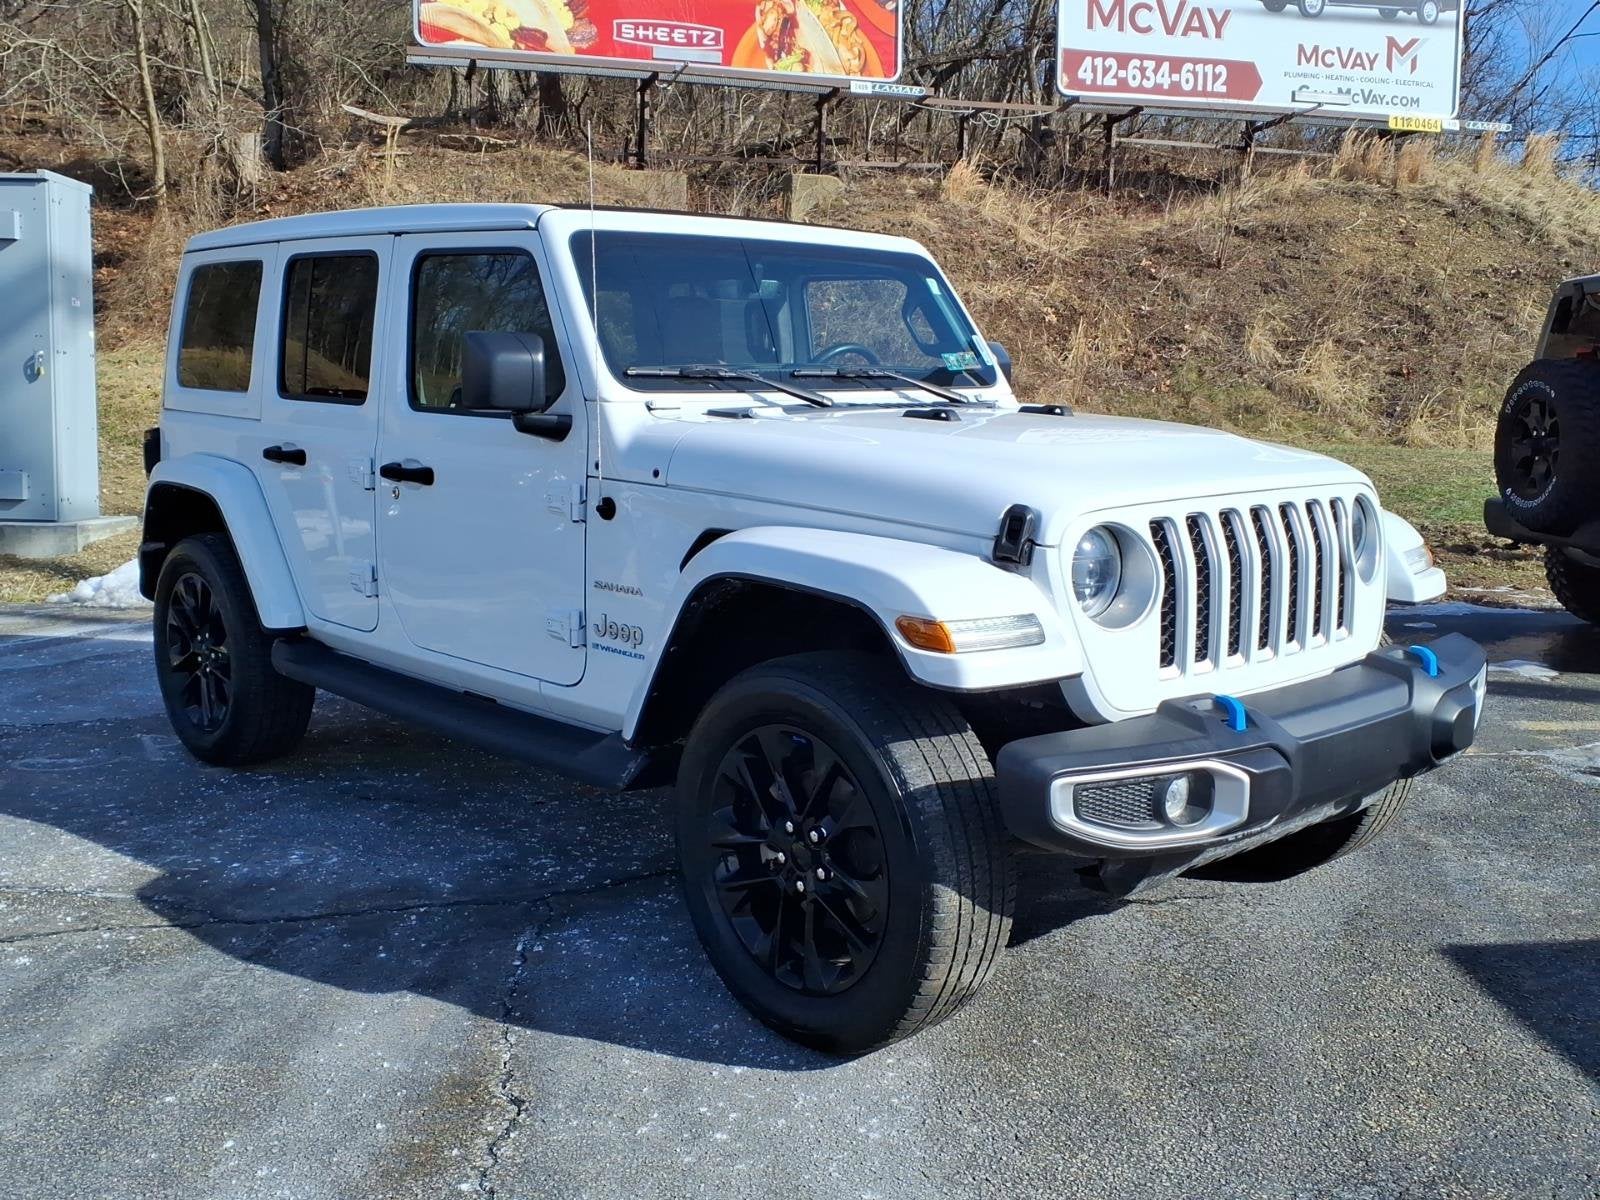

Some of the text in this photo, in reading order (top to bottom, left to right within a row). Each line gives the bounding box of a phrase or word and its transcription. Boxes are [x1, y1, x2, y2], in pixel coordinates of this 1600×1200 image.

[621, 24, 716, 45] SHEETZ
[1077, 56, 1228, 93] 412-634-6112
[1284, 71, 1434, 89] PLUMBING HEATING COOLING ELECTRICAL
[874, 83, 920, 95] LAMAR
[1298, 84, 1420, 108] McVAY.COM
[593, 581, 643, 596] SAHARA
[593, 613, 644, 649] Jeep
